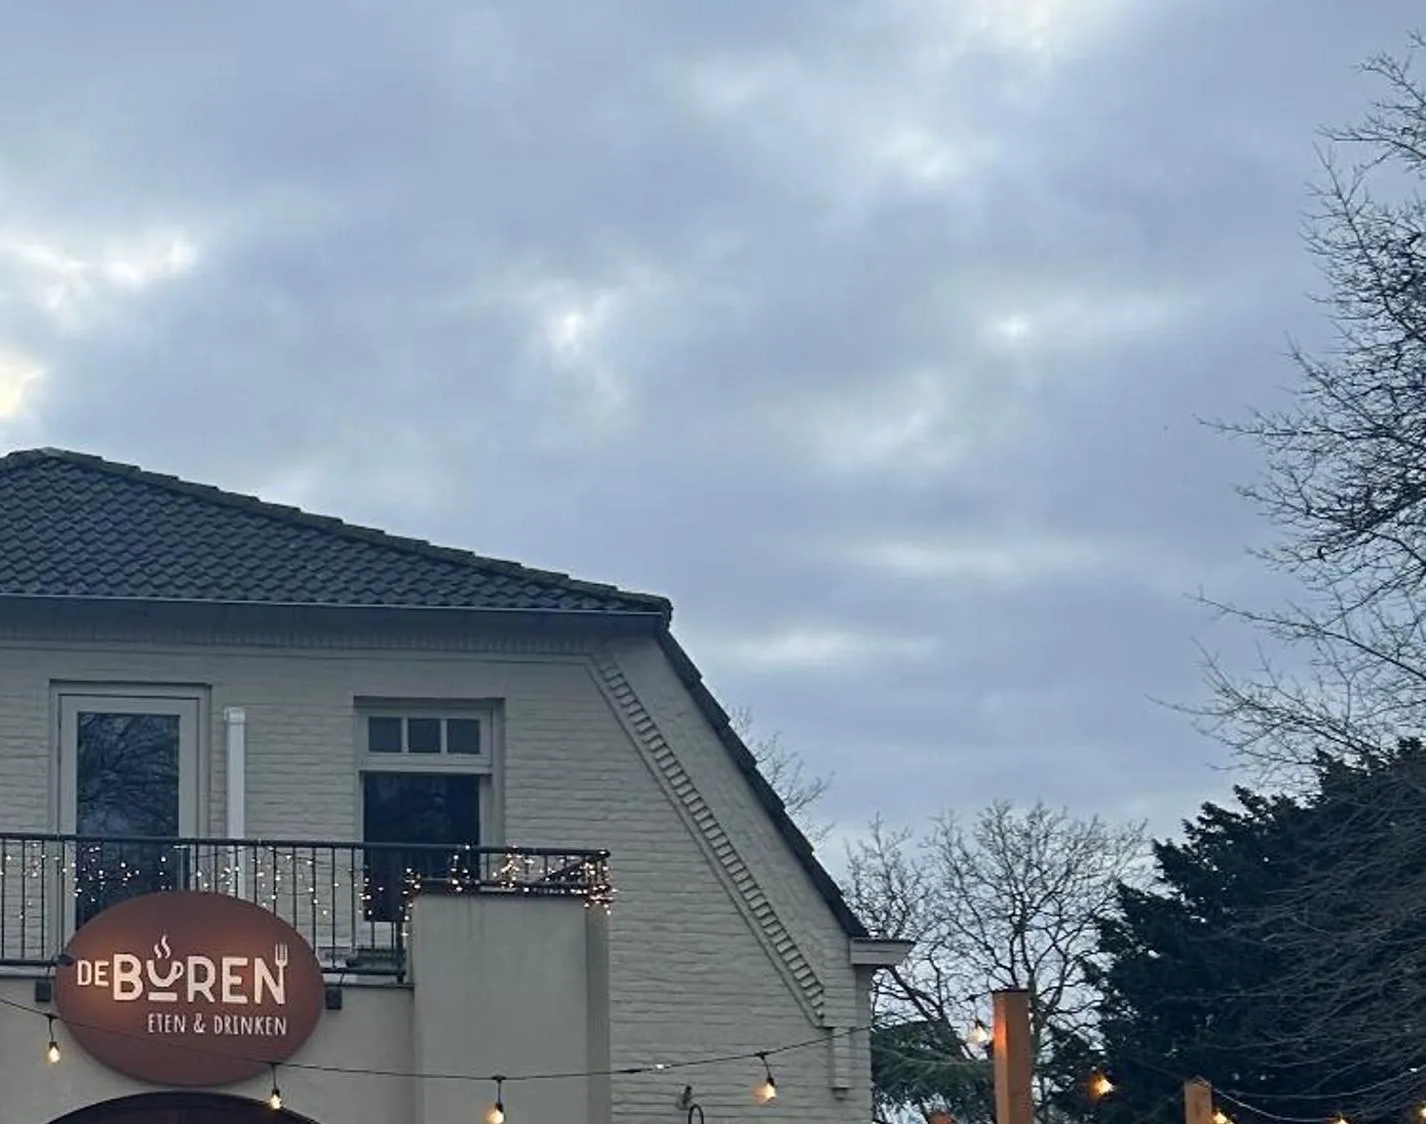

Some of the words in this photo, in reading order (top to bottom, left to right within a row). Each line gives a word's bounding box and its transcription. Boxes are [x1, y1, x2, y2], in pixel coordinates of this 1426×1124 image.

[76, 959, 110, 987] DE
[112, 943, 289, 1005] BUREN
[147, 1012, 187, 1034] ETEN
[192, 1012, 207, 1034] &
[213, 1014, 288, 1036] DRINKEN
